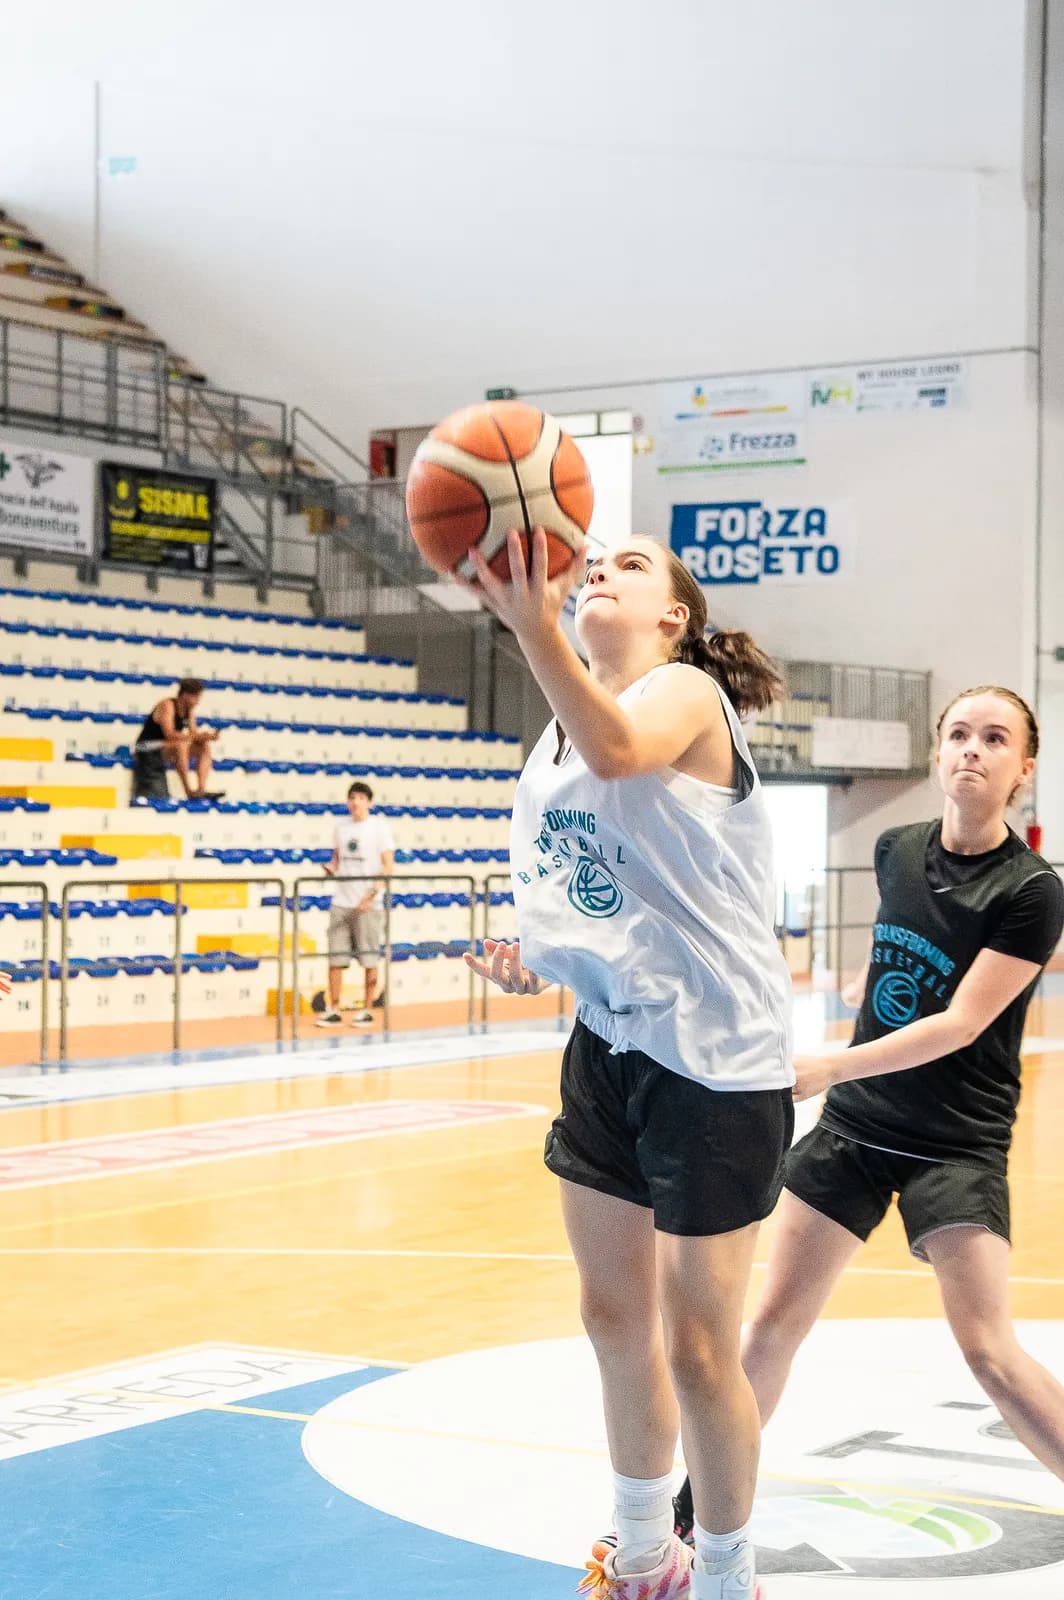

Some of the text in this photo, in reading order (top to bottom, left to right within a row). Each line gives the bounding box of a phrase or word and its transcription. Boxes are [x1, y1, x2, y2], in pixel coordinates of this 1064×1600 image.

[729, 431, 797, 451] Frezza
[694, 507, 827, 543] FORZA
[681, 544, 839, 579] ROSETO
